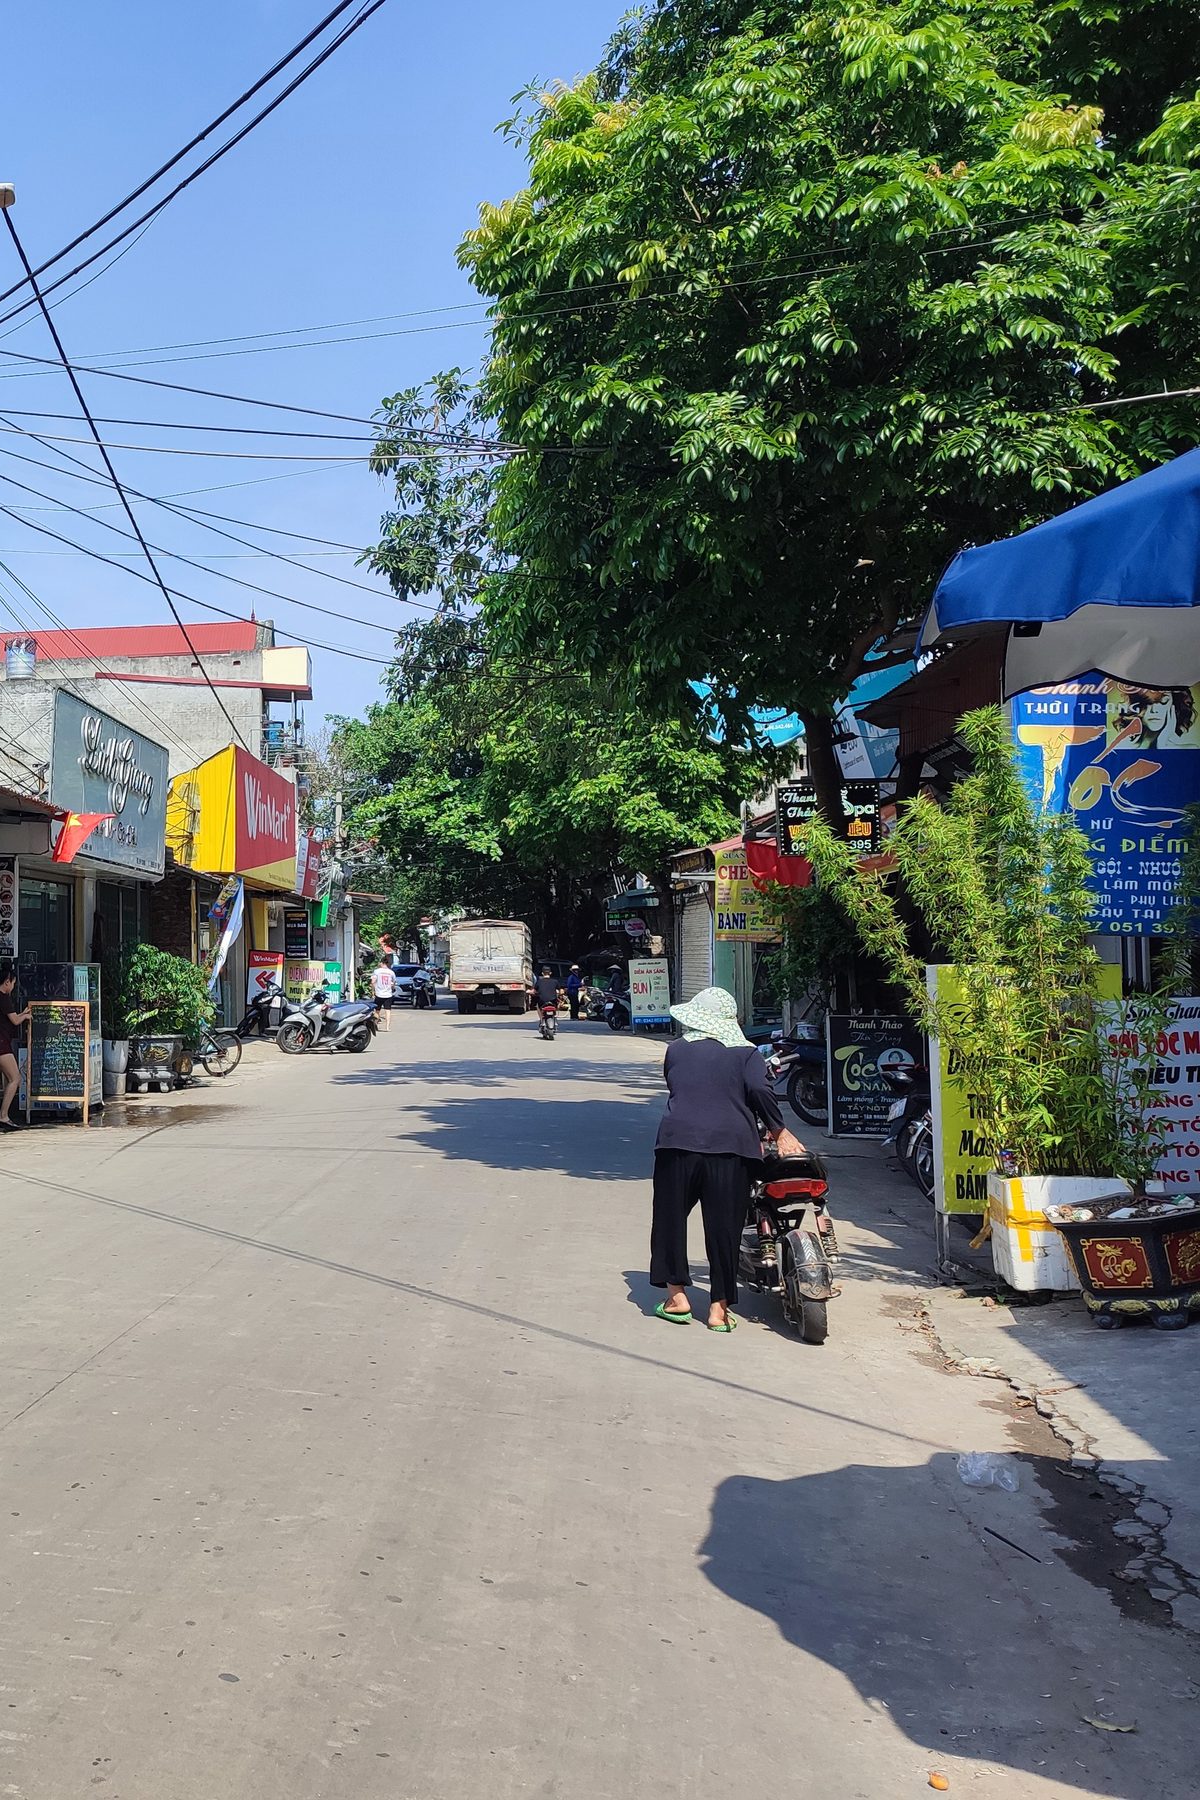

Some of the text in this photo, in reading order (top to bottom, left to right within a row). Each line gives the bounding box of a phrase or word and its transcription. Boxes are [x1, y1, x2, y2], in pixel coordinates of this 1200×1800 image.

[717, 861, 749, 880] CHÈ
[1096, 857, 1183, 879] GỘI NHUỘ
[717, 908, 747, 929] BÁNH
[1110, 922, 1143, 932] 051
[848, 1020, 903, 1029] Thanh Thảo
[861, 1082, 892, 1091] NAM
[956, 1165, 987, 1200] BẤM
